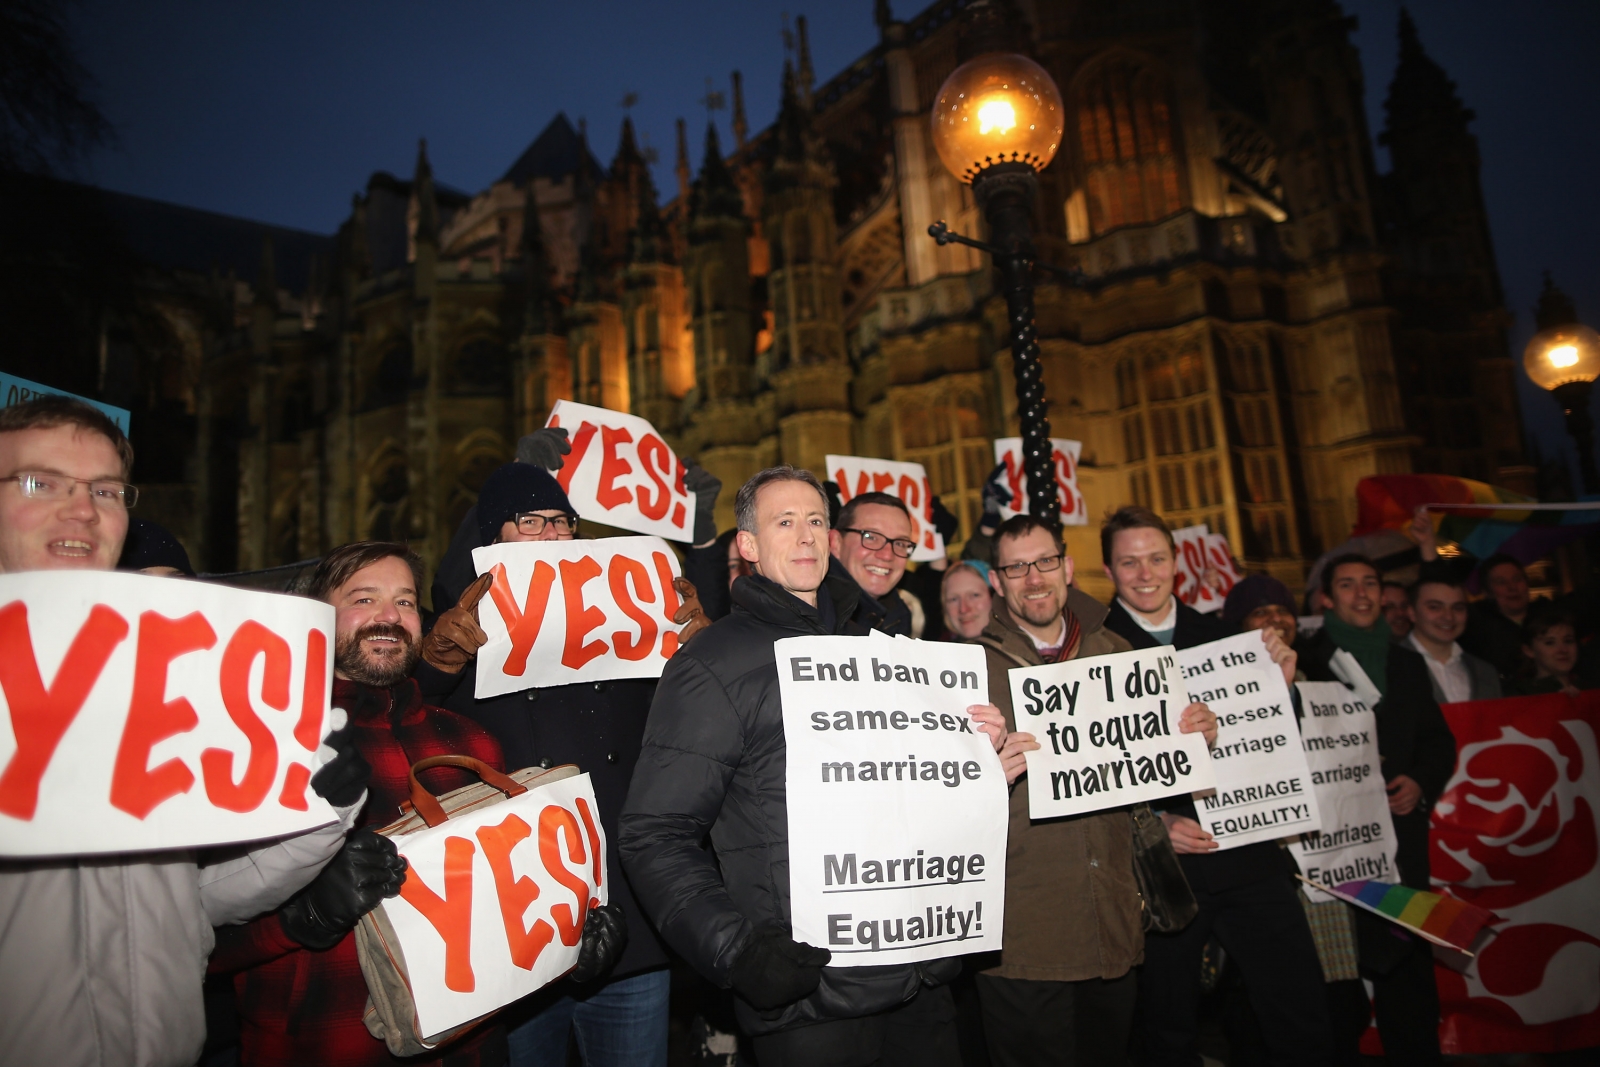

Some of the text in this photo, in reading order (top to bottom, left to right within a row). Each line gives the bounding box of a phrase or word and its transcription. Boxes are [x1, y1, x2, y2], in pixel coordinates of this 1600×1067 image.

[488, 551, 683, 676] YES!
[790, 656, 979, 689] End ban on
[1221, 651, 1257, 668] the
[1022, 678, 1080, 716] Say
[1187, 680, 1260, 704] ban on
[1310, 700, 1338, 717] ban
[1342, 701, 1367, 715] on
[0, 599, 327, 821] YES!
[810, 709, 973, 734] same-sex
[1046, 700, 1170, 755] to equal
[1212, 734, 1287, 759] arriage
[821, 755, 982, 787] marriage
[1051, 750, 1192, 800] marriage
[1311, 763, 1370, 785] arriage
[1203, 778, 1303, 809] MARRIAGE
[1211, 803, 1310, 836] EQUALITY!
[1301, 822, 1381, 851] Marriage
[823, 850, 985, 885] Marriage
[1307, 852, 1389, 889] Equality!
[827, 901, 983, 951] Equality!
